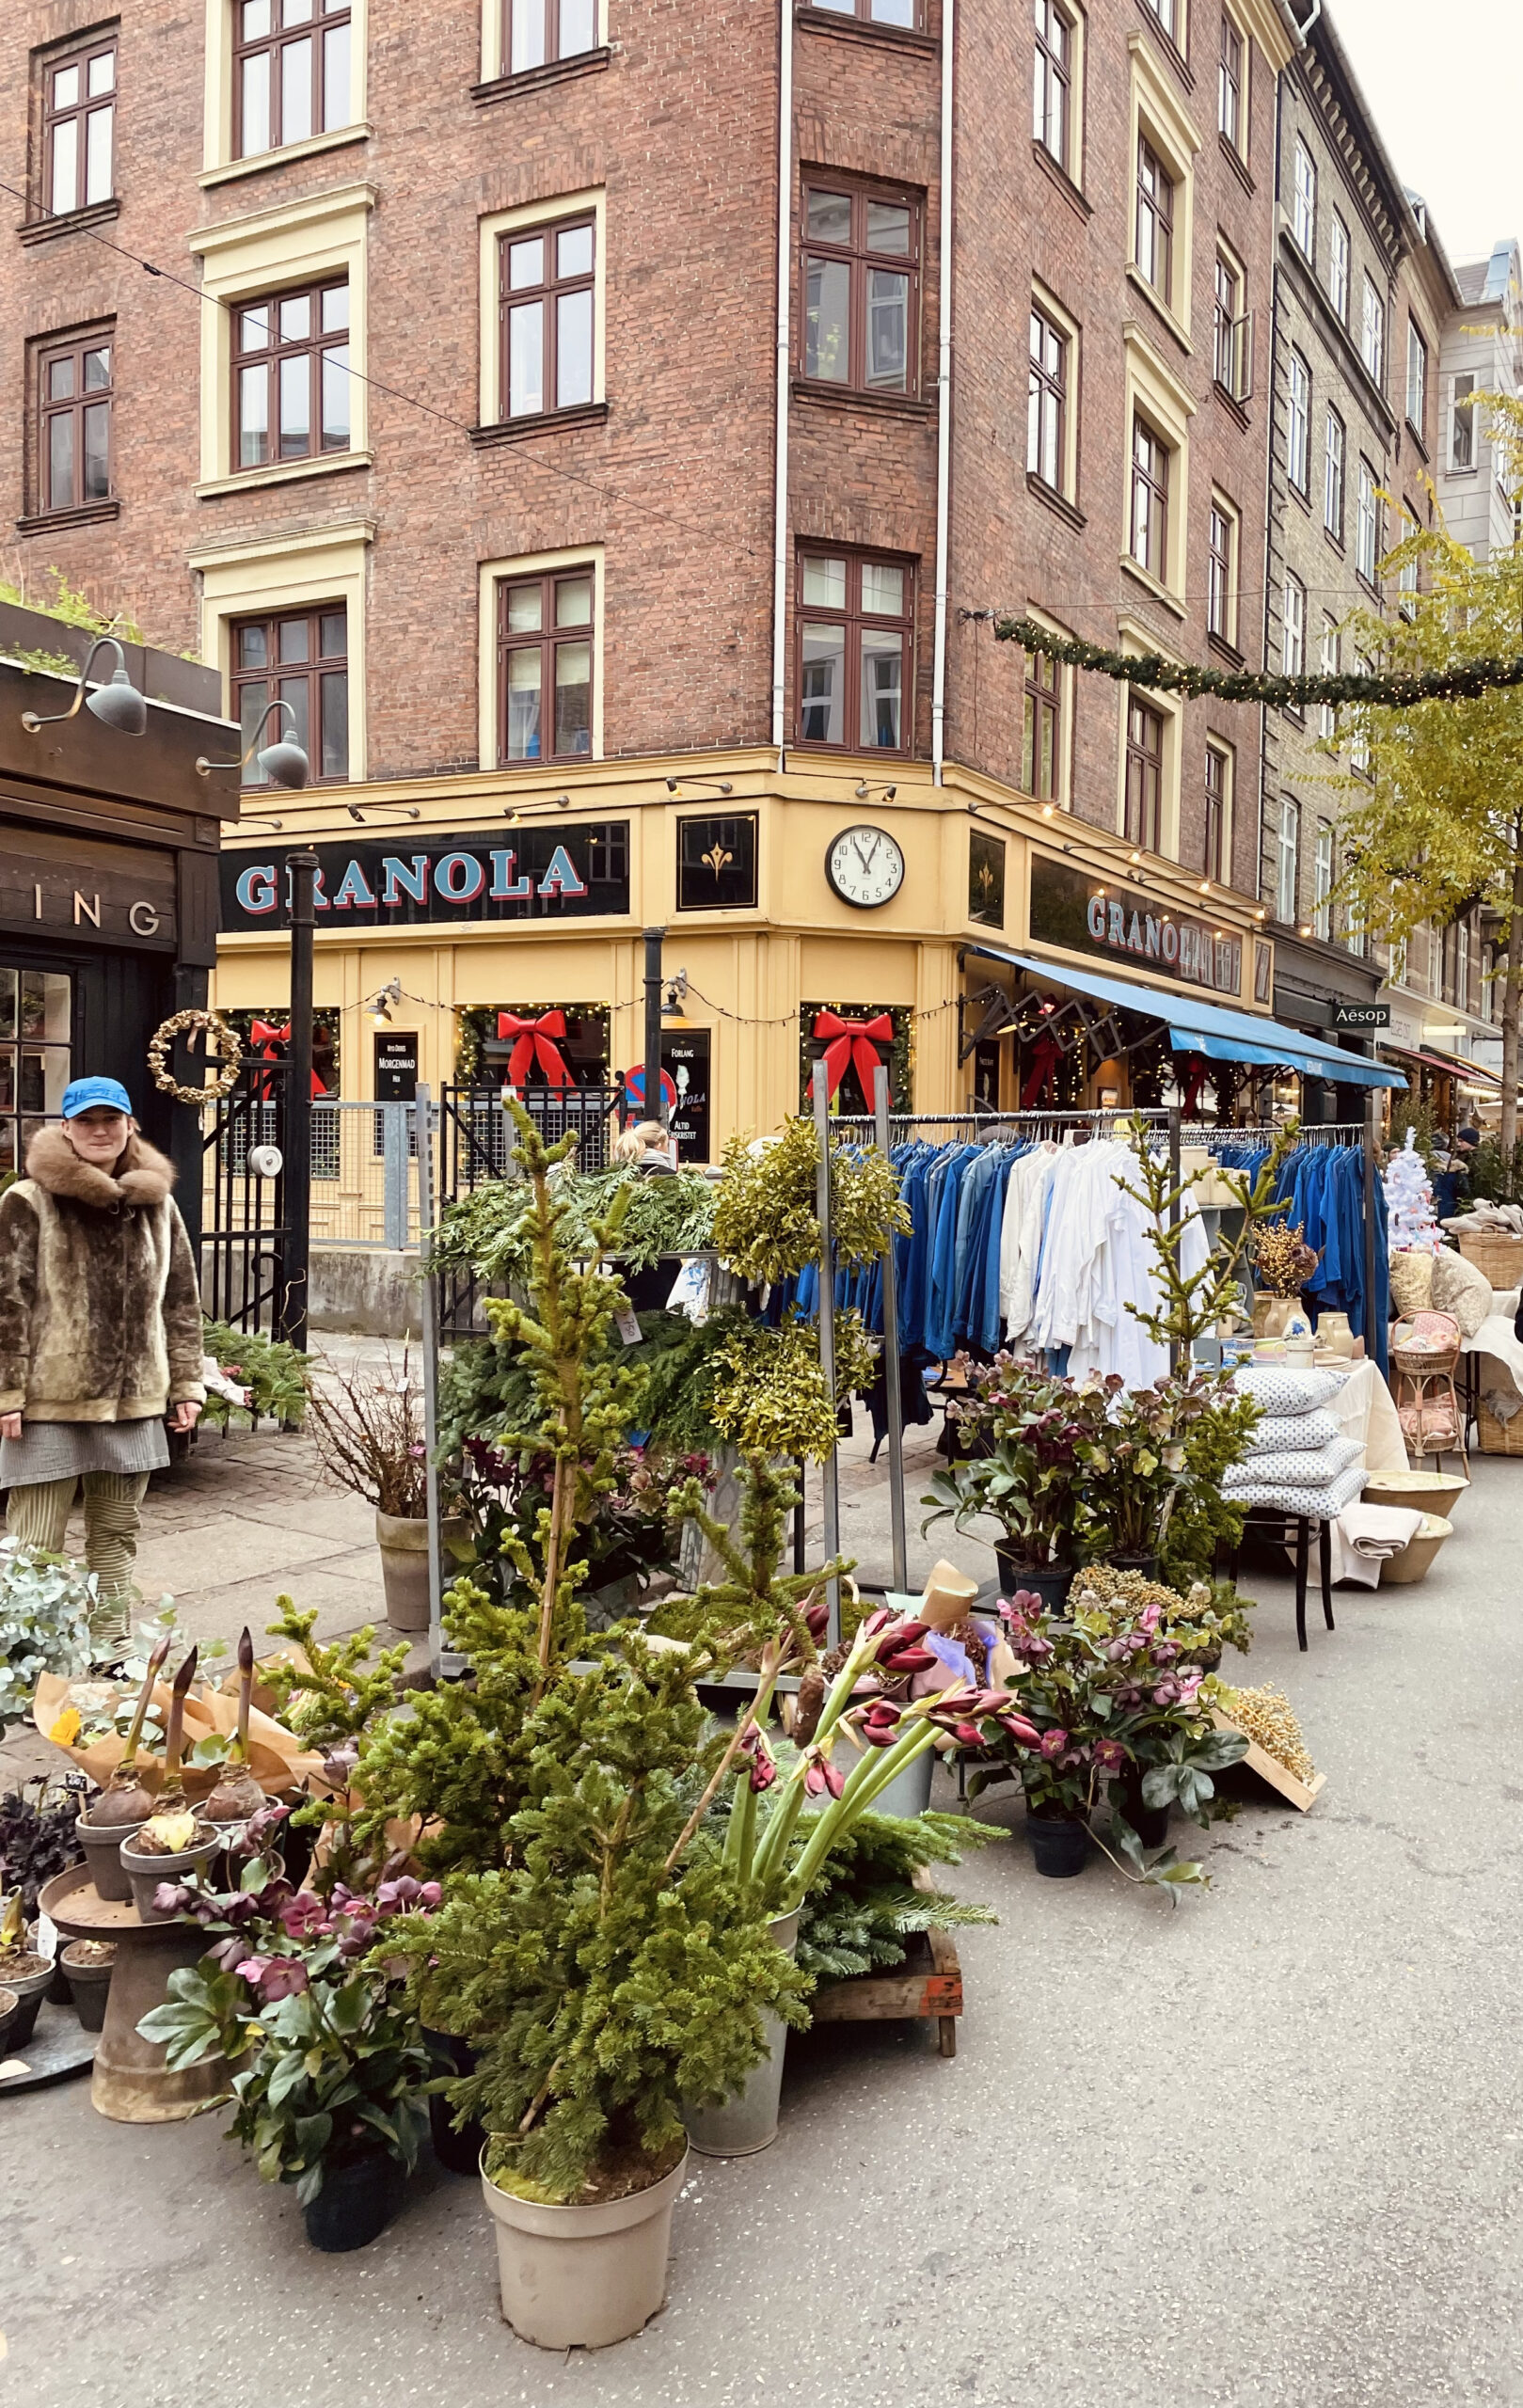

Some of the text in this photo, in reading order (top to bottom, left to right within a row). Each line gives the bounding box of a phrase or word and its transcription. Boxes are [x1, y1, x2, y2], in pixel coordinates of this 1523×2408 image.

[861, 832, 871, 843] 12
[838, 845, 848, 856] 10
[885, 848, 893, 859] 2
[833, 859, 841, 870] 9
[890, 863, 897, 874] 3
[838, 874, 847, 885] 8
[884, 877, 893, 887] 4
[849, 885, 857, 895] 7
[862, 890, 869, 900] 6
[875, 887, 882, 898] 5
[35, 883, 160, 936] ING
[378, 1057, 416, 1069] MORGENMAD
